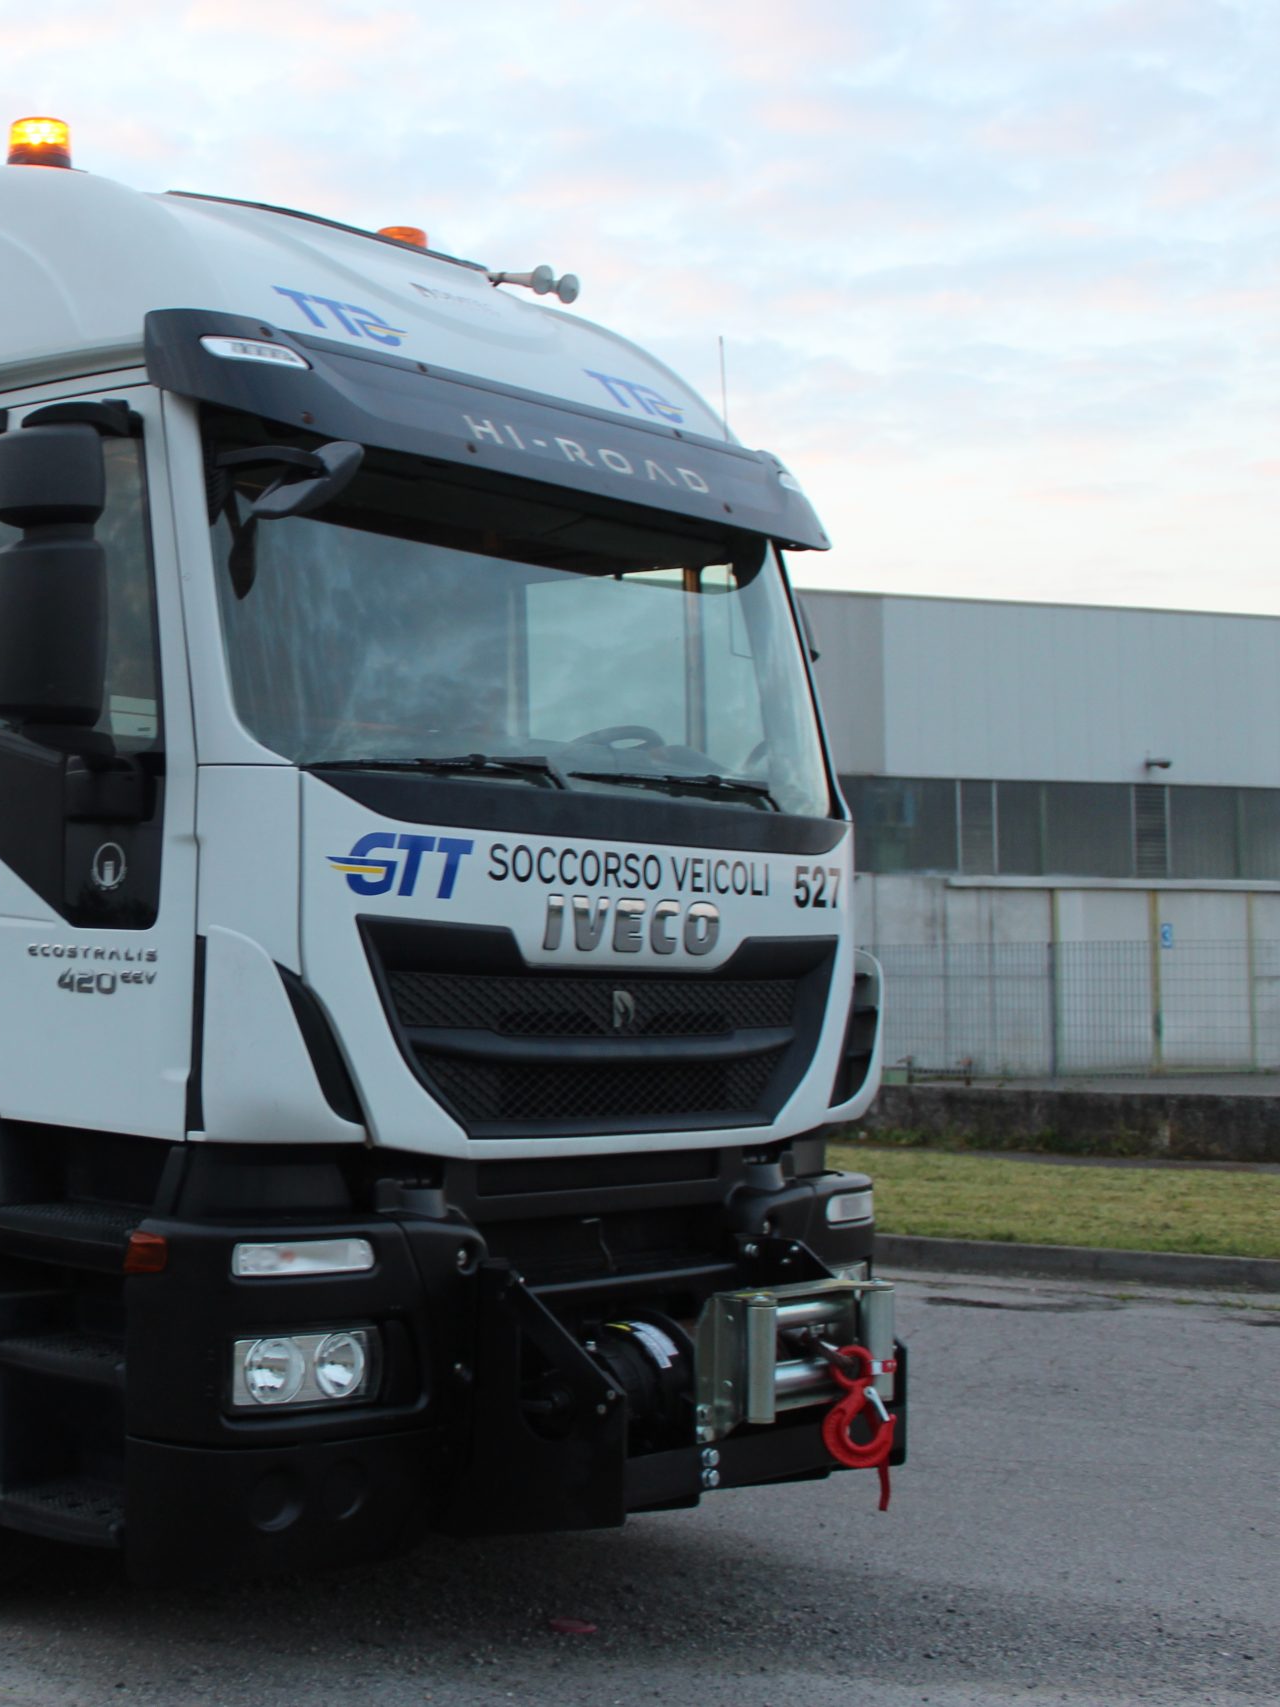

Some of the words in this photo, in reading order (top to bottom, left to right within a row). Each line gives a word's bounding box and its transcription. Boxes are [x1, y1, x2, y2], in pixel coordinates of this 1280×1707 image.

[462, 414, 710, 494] HI-ROAD
[325, 831, 475, 900] GTT
[487, 842, 662, 891] SOCCORSO
[670, 856, 770, 897] VEICOLI
[793, 865, 842, 909] 527
[27, 943, 158, 963] ECOSTRALIS
[542, 893, 720, 956] IVECO
[57, 966, 117, 995] 420
[120, 969, 158, 985] EEV
